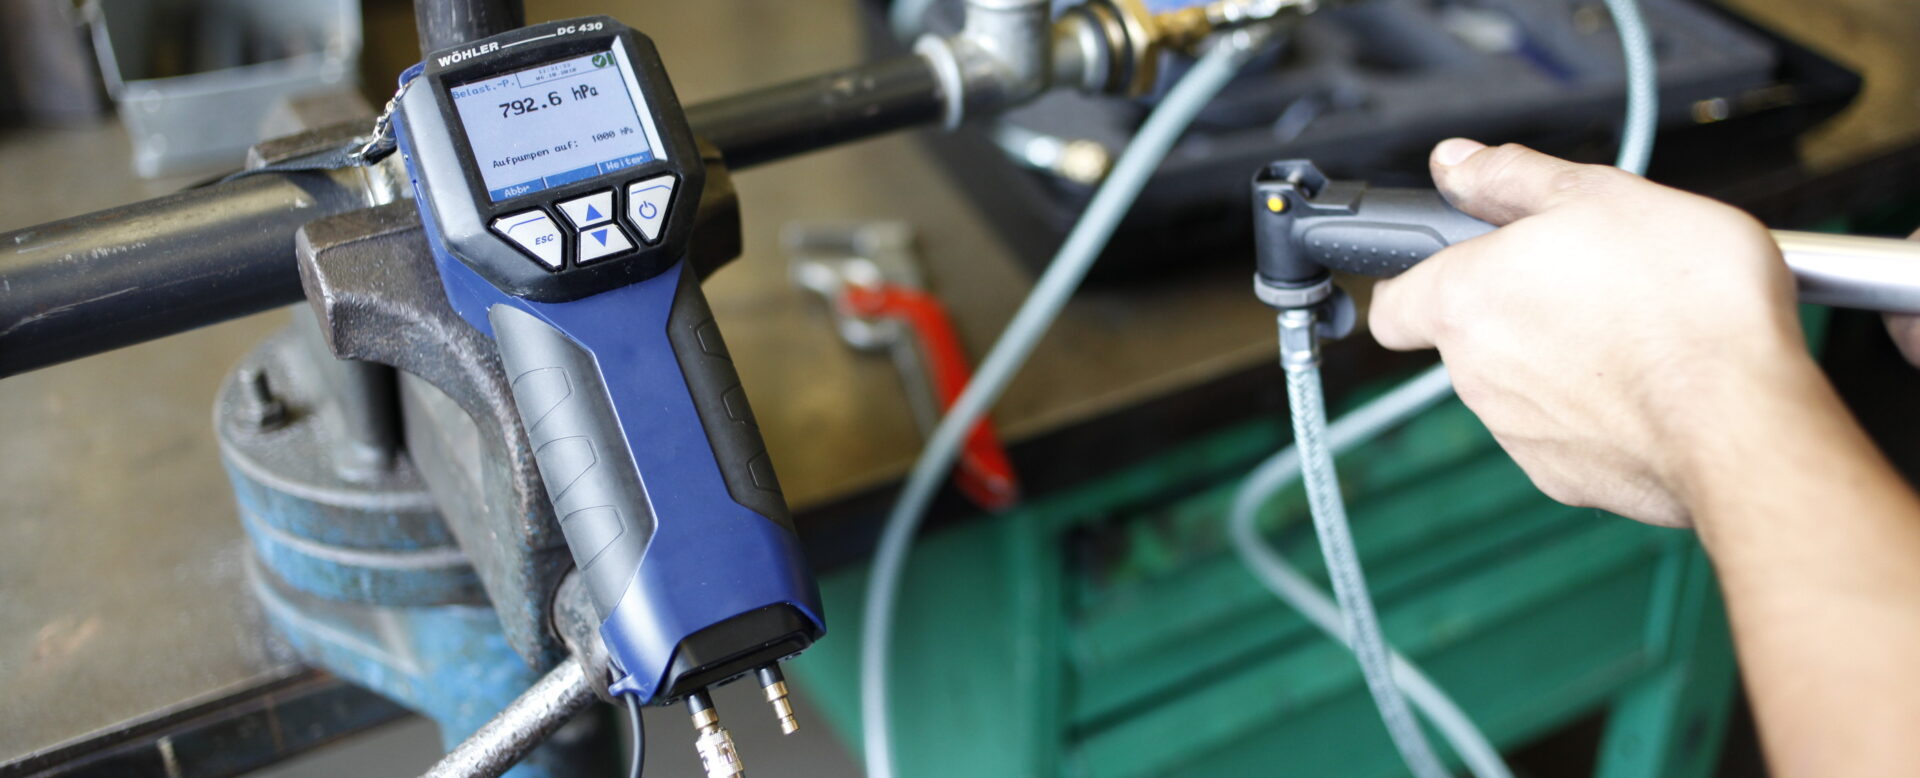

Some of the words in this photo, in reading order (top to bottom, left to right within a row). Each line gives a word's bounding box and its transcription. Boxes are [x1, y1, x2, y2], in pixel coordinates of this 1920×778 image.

[437, 41, 499, 68] WÖHLER
[557, 27, 576, 36] DC
[578, 22, 603, 33] 430
[499, 92, 562, 118] 792.6
[571, 84, 598, 101] hPa
[493, 149, 549, 169] Aufpumpen
[554, 141, 579, 154] auf:
[592, 130, 616, 142] 1000
[535, 234, 554, 245] ESC
